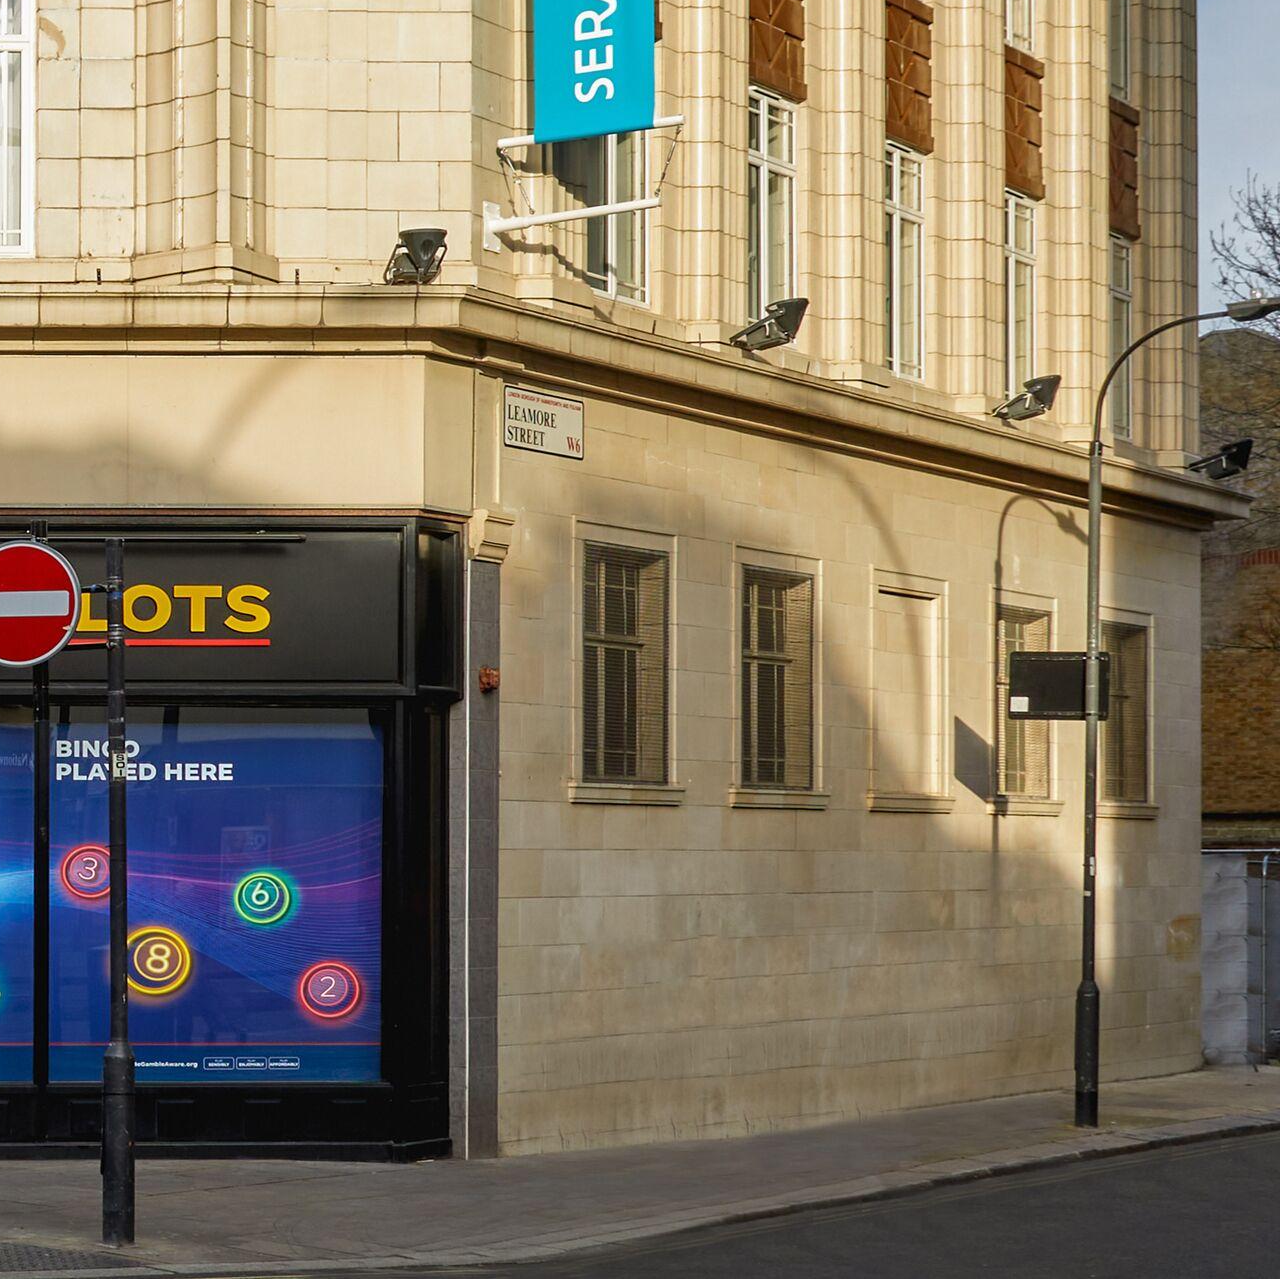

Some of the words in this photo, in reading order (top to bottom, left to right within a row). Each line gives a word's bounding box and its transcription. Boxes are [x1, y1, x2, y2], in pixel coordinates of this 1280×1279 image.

[508, 404, 557, 428] LEAMORE
[507, 425, 545, 447] STREET
[566, 436, 581, 454] W6
[75, 584, 271, 633] LOTS
[165, 763, 234, 781] HERE
[77, 857, 98, 880] 3
[251, 881, 269, 906] 6
[145, 942, 171, 975] 8
[319, 975, 337, 999] 2
